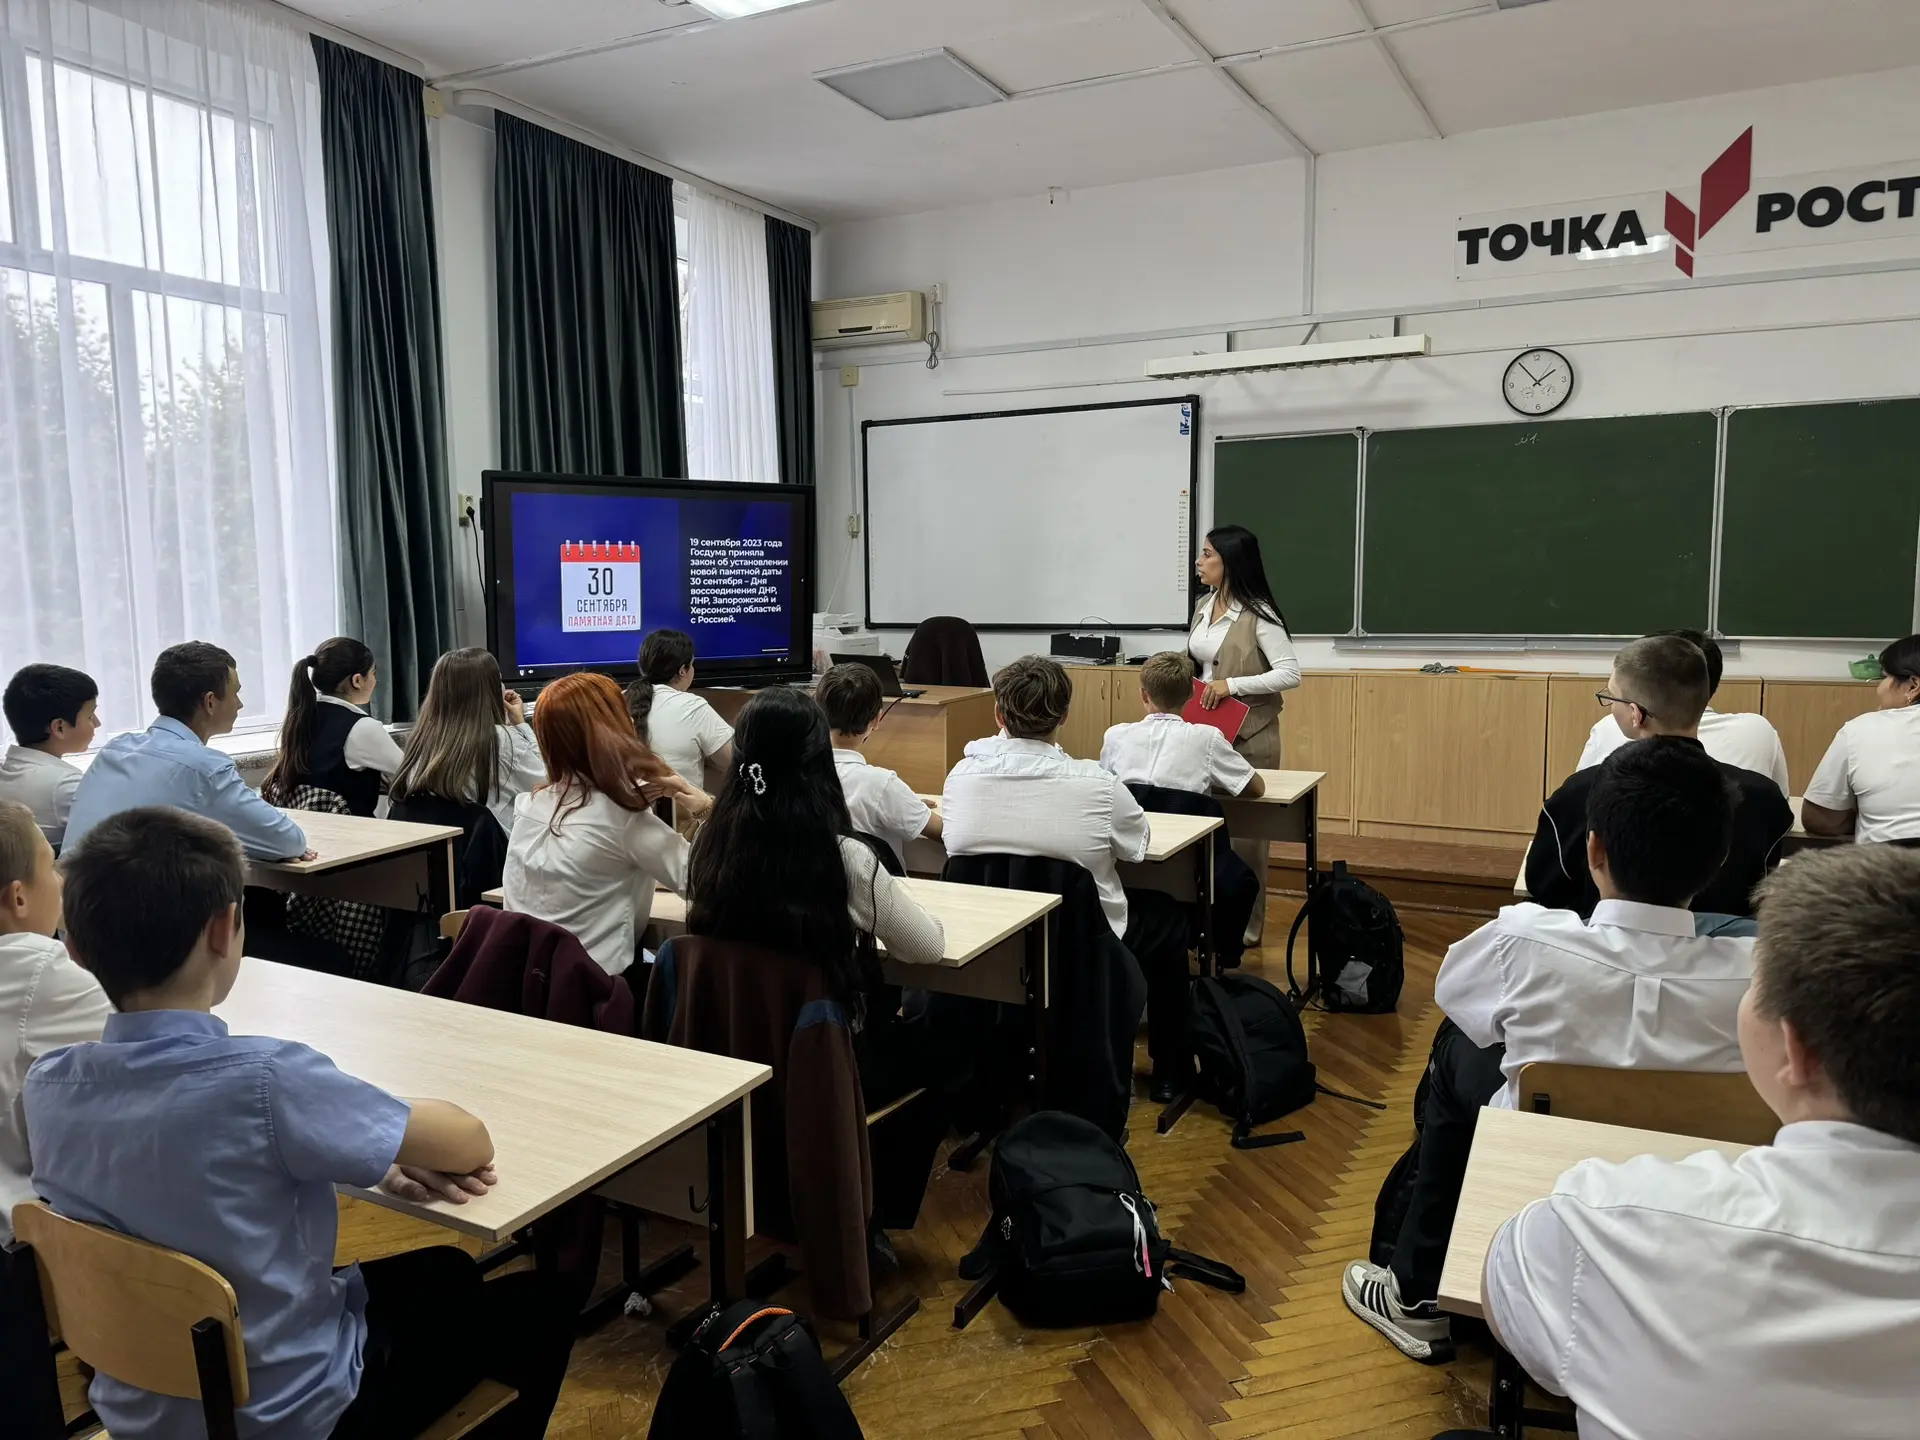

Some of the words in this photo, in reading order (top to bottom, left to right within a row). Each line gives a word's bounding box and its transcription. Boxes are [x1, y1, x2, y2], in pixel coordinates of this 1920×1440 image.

[1458, 209, 1647, 265] ТОЧКА
[1756, 175, 1920, 233] РОСТ
[690, 538, 699, 546] 19
[701, 538, 740, 547] сентября
[690, 548, 726, 557] Госдума
[588, 568, 613, 595] 30
[703, 578, 742, 586] сентября
[759, 587, 777, 595] ДНР,
[690, 597, 710, 605] ЛНР,
[713, 596, 768, 605] Запорожской
[577, 599, 627, 612] СЕНТЯБРЯ
[691, 606, 741, 615] Херсонской
[743, 605, 781, 613] областей
[569, 616, 612, 626] ПАМЯТНАЯ
[616, 615, 636, 626] ДАТА
[698, 615, 736, 623] Россией.
